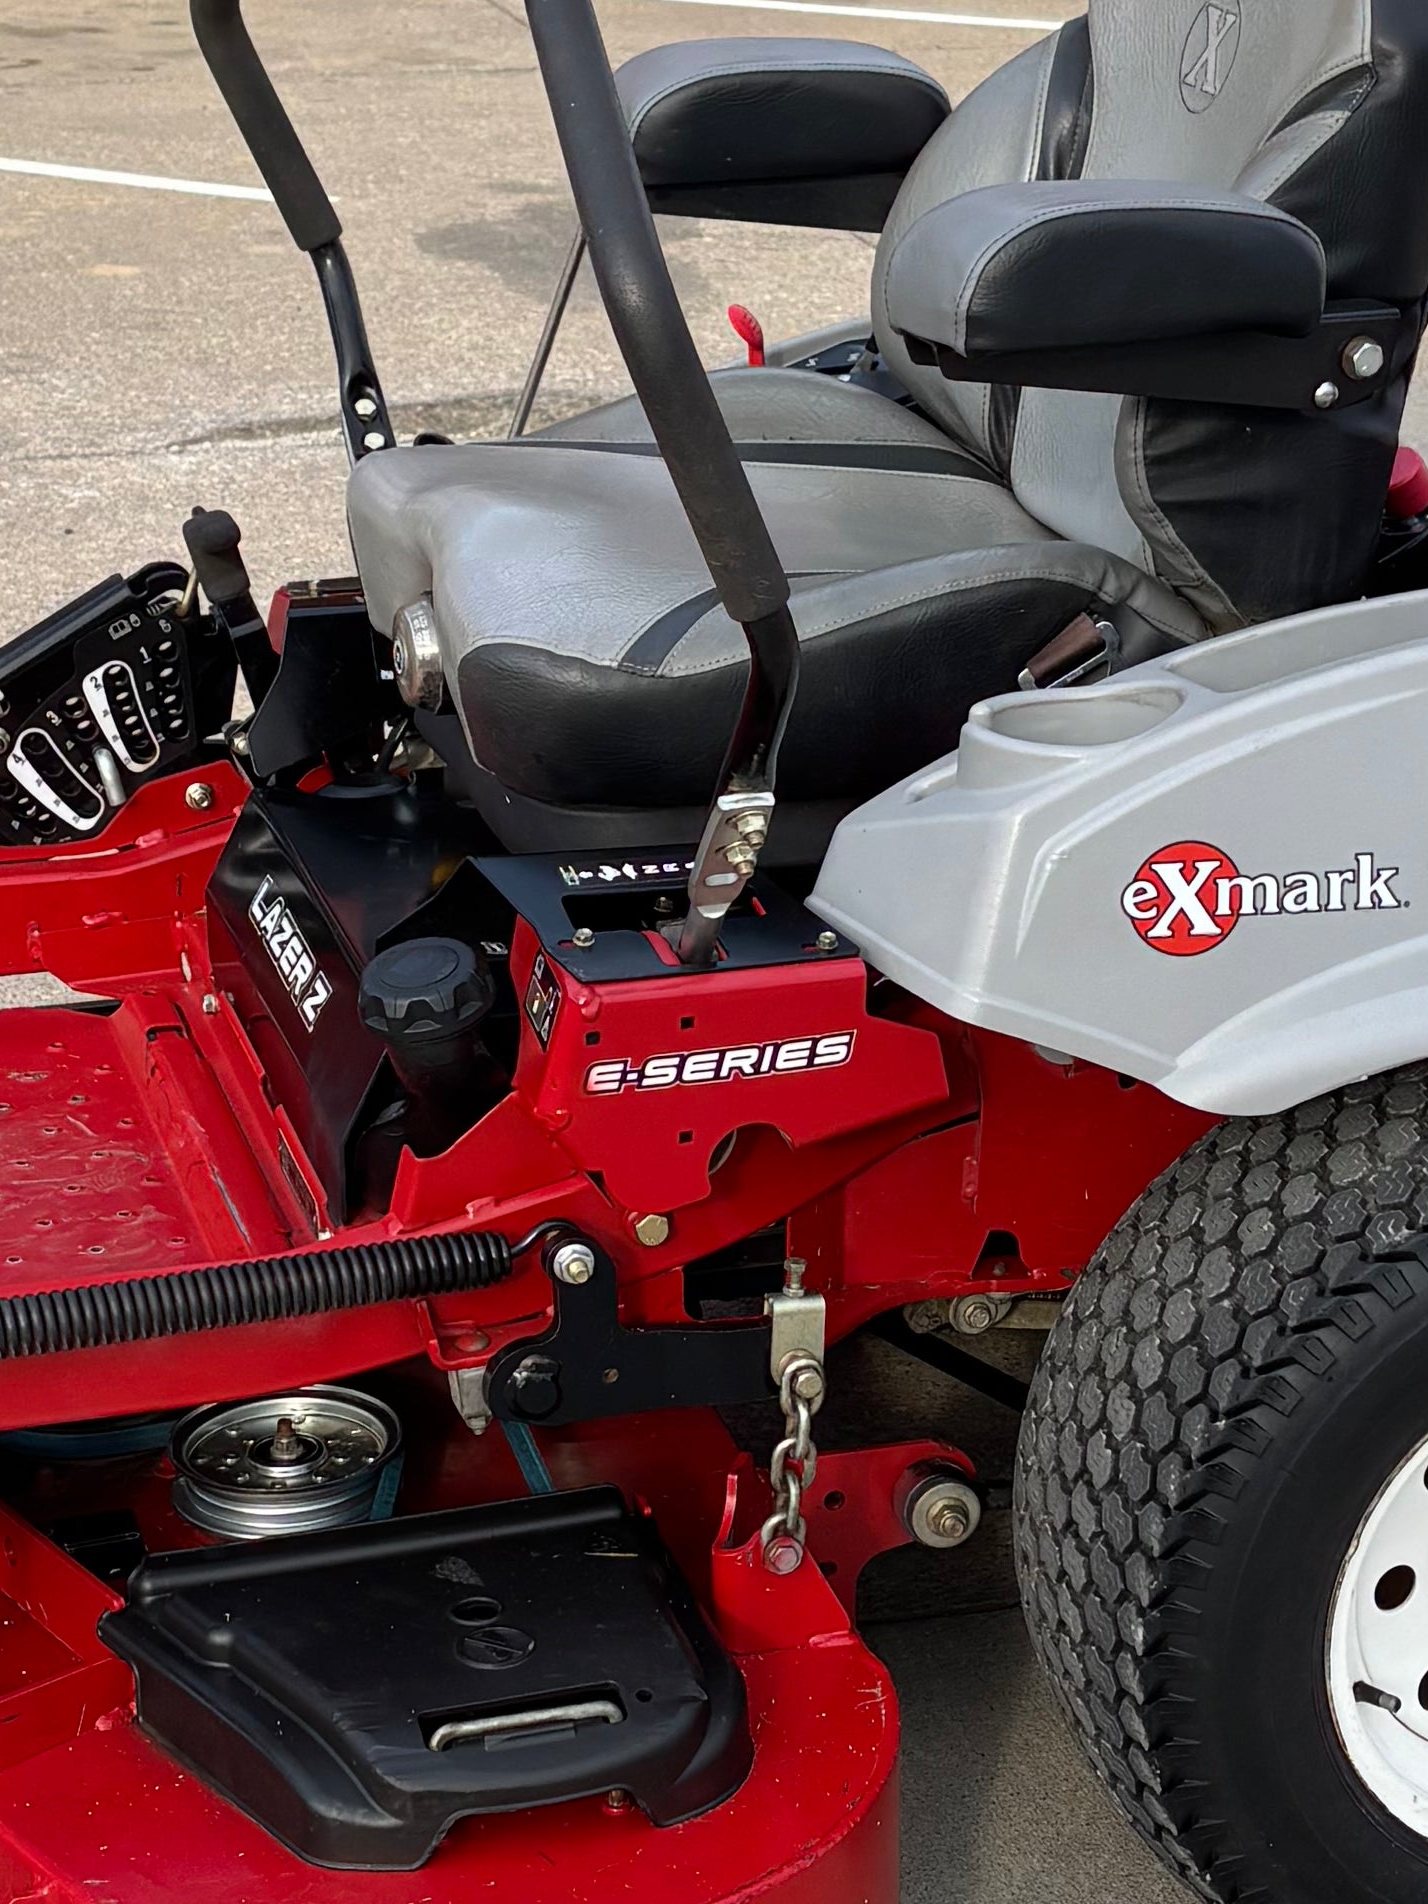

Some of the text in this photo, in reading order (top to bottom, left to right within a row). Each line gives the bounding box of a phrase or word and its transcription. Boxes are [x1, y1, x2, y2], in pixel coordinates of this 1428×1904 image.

[250, 876, 331, 1028] LAZER Z
[585, 1032, 855, 1094] E-SERIES
